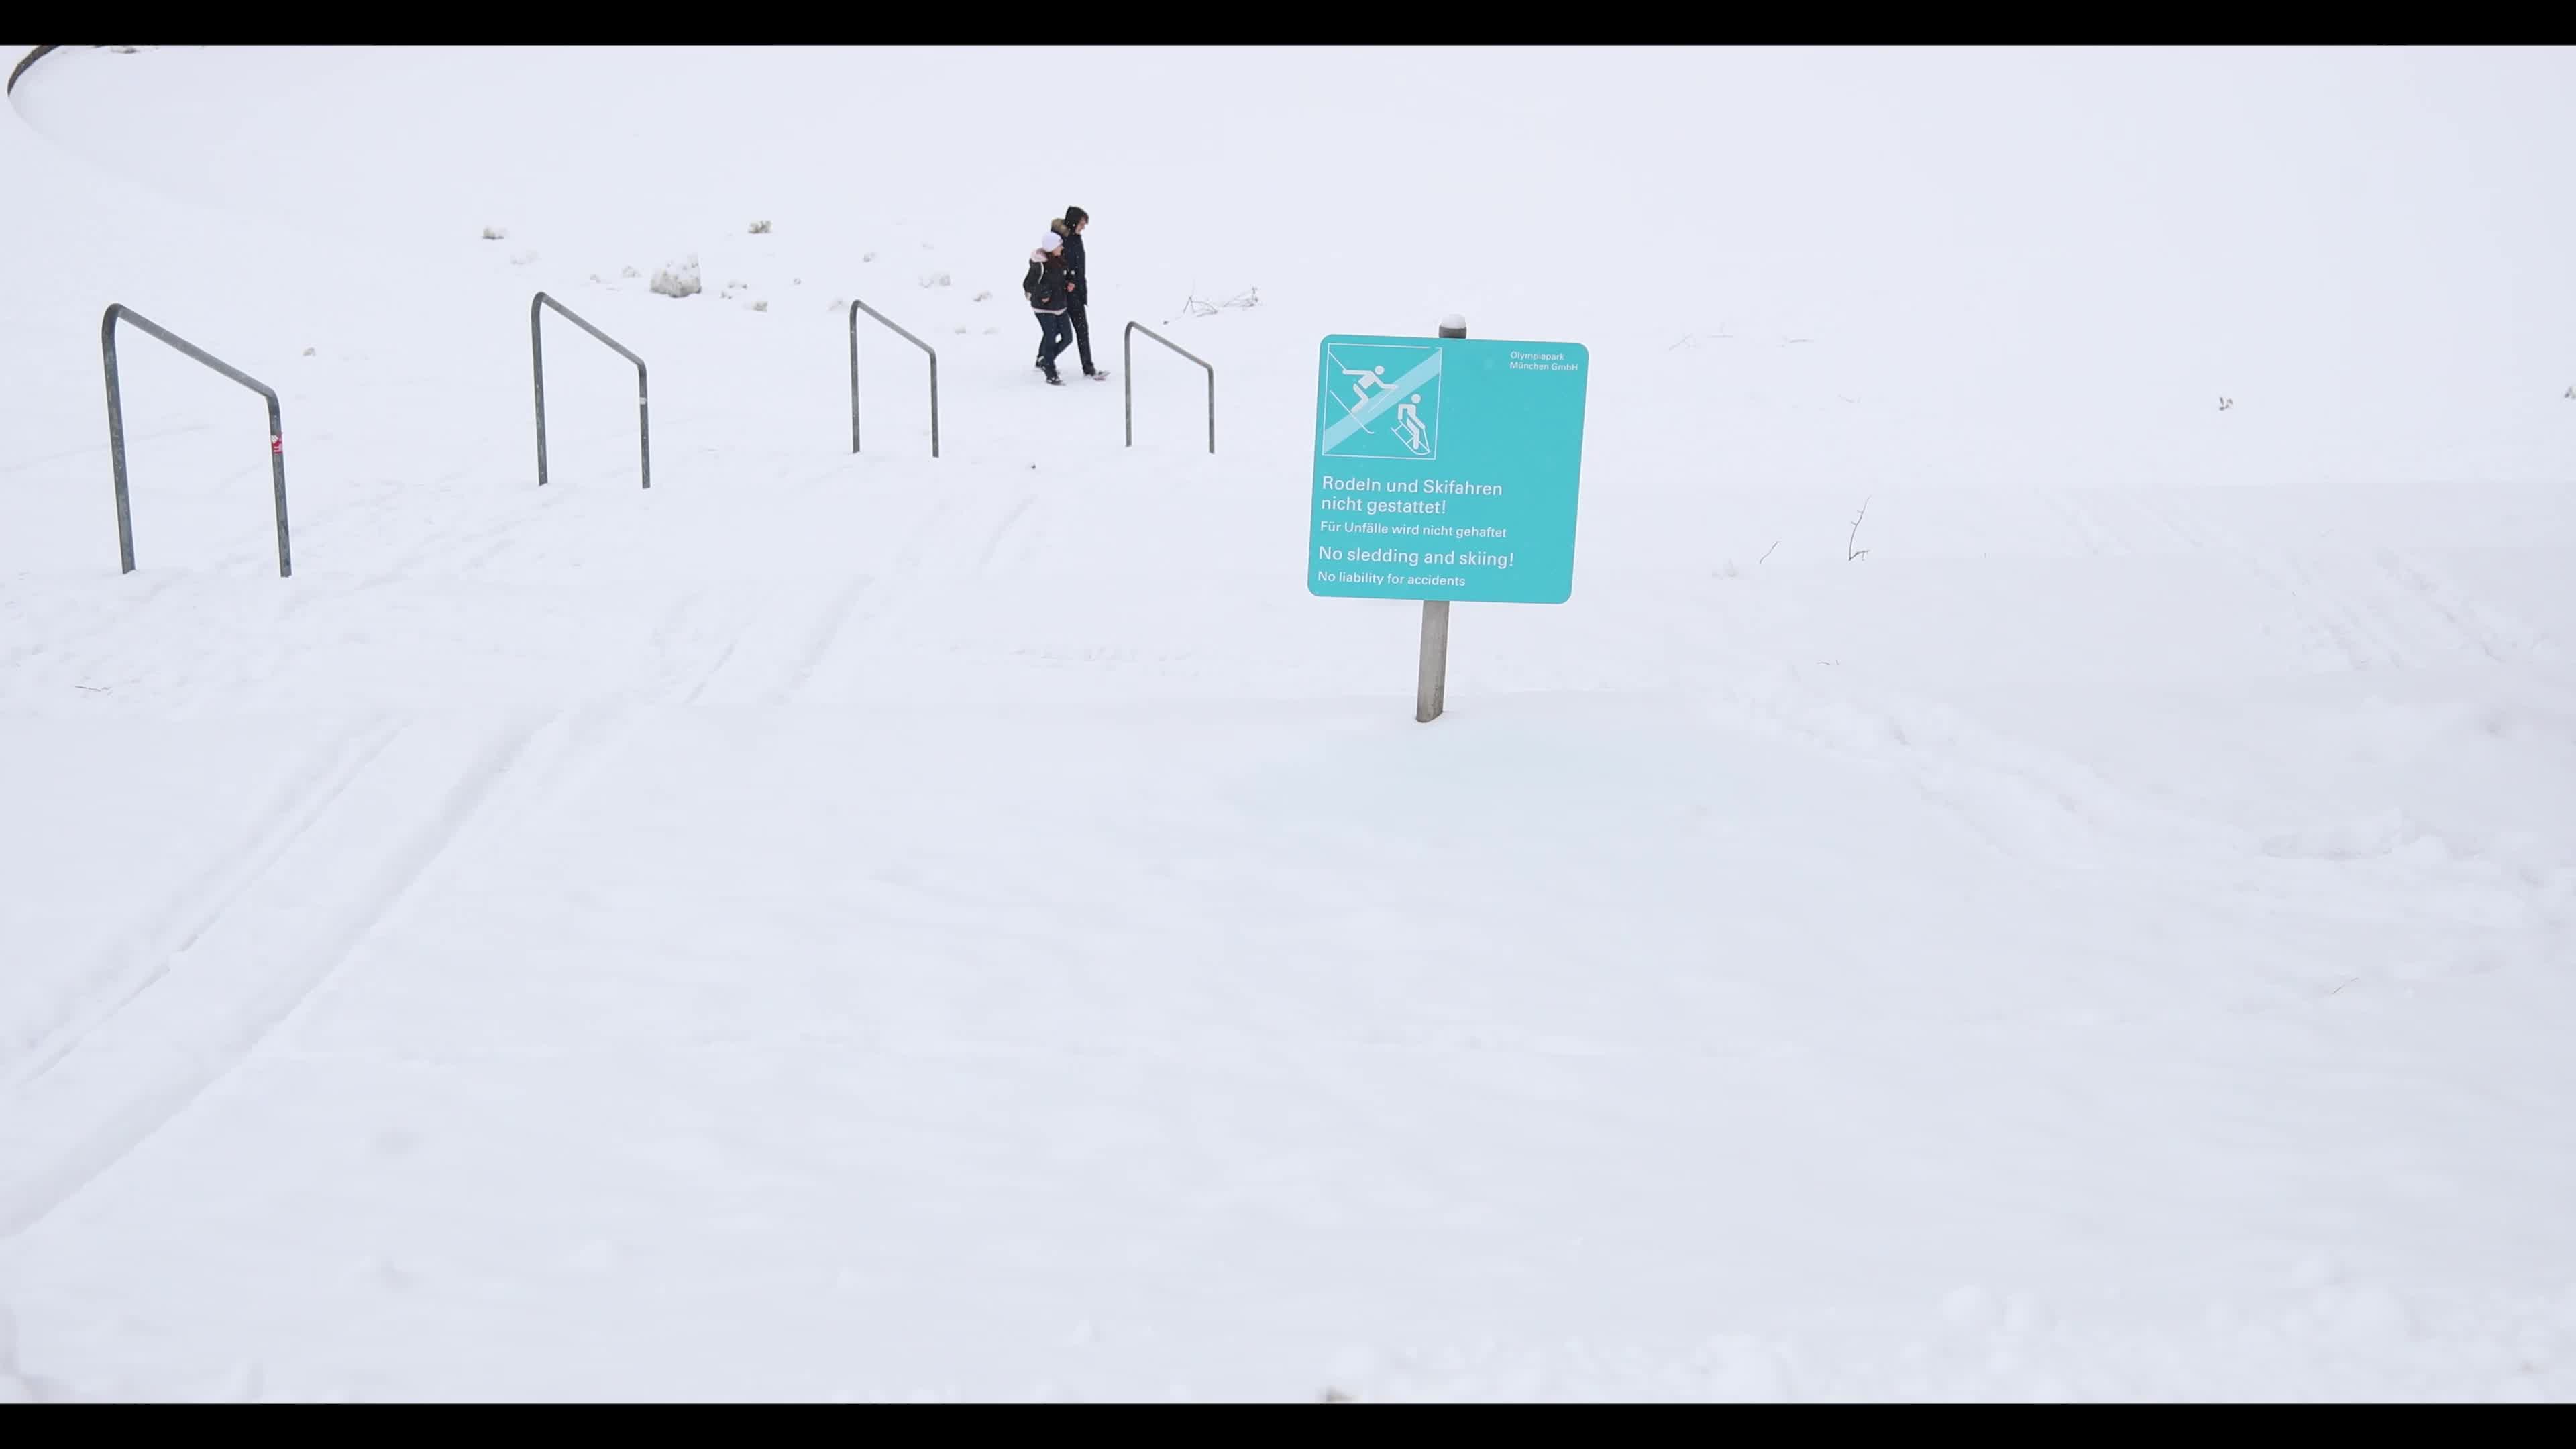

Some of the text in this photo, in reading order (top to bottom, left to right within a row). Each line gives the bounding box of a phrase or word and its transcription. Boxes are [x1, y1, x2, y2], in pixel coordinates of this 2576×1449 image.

[1510, 351, 1564, 360] Olympiapark
[1510, 362, 1549, 370] München
[1322, 476, 1502, 495] Rodeln und Skifahren
[1321, 496, 1446, 515] nicht gestattet!
[1320, 521, 1507, 538] Für Unfälle wird nicht gehaftet
[1319, 546, 1514, 569] No sledding and skiing!
[1318, 571, 1466, 586] No liability for accidents
